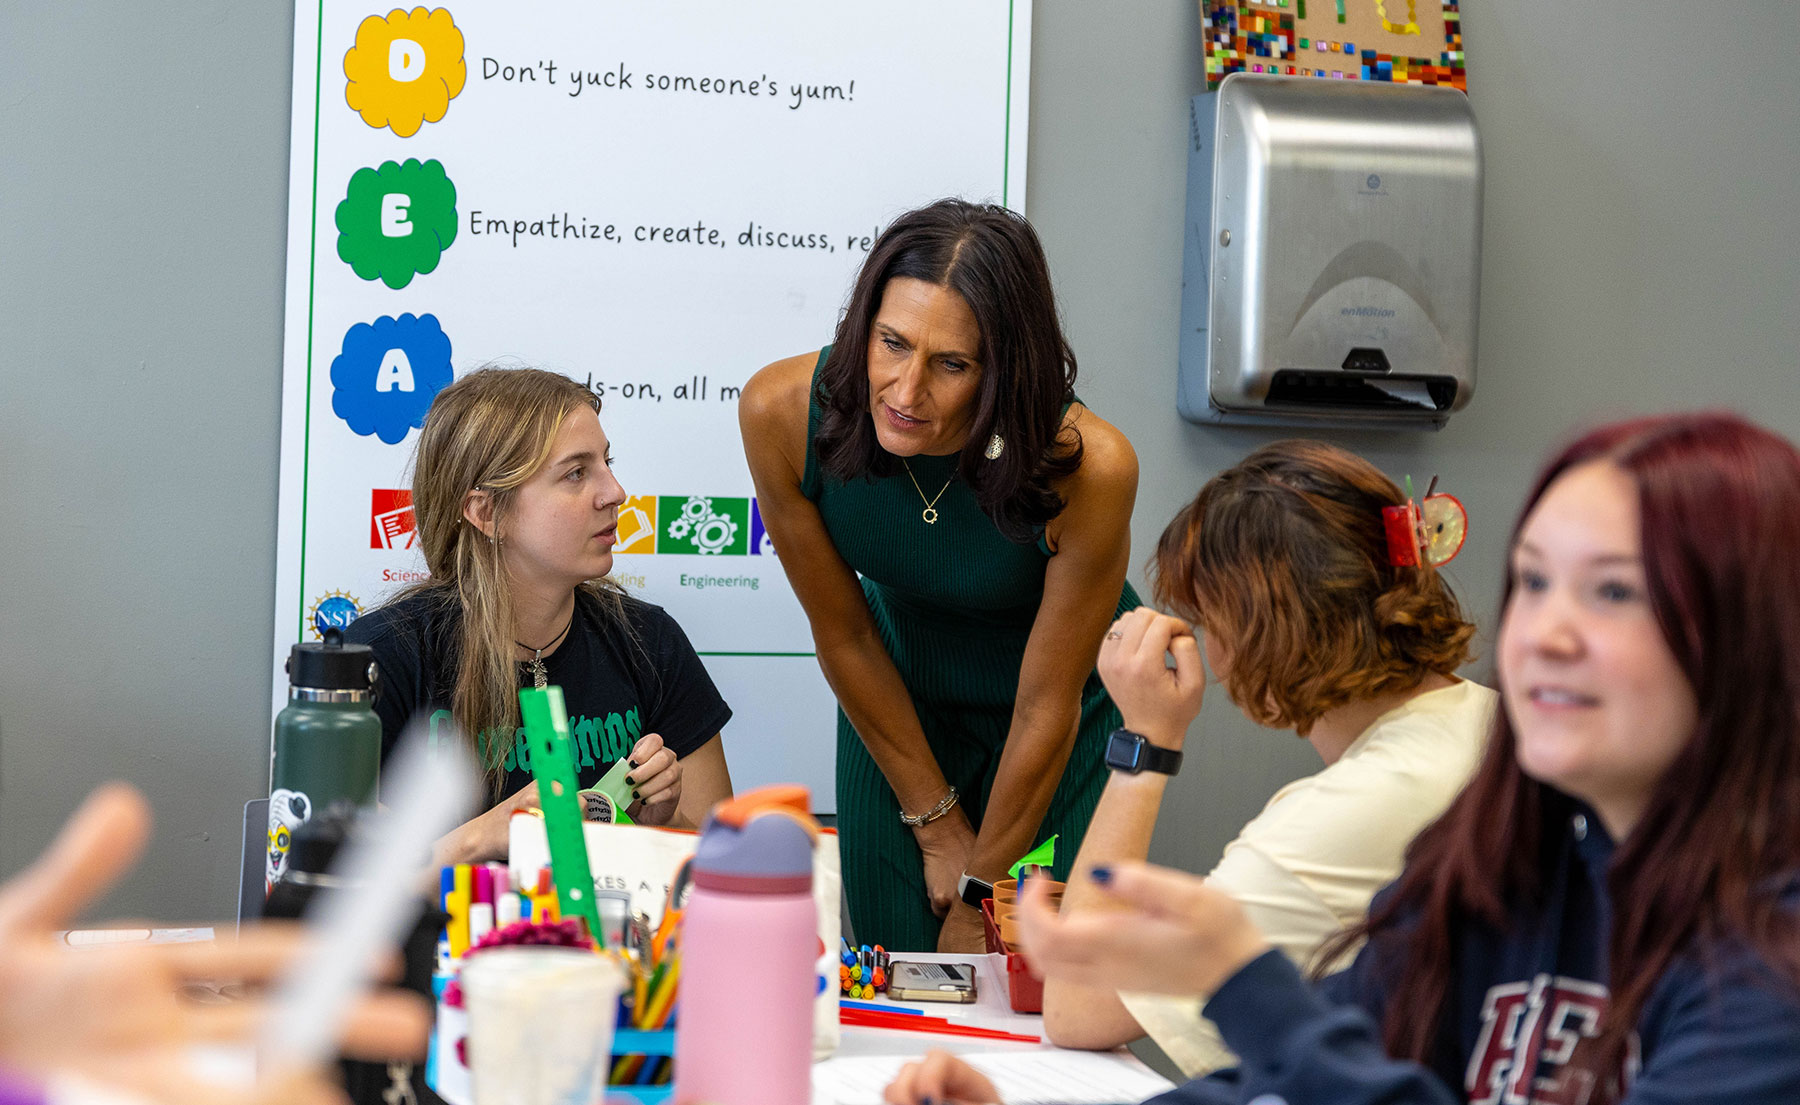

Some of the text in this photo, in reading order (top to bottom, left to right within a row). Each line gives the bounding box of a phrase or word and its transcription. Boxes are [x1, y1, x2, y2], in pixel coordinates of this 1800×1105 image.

[388, 38, 426, 82] D
[482, 57, 855, 110] Don't yuck someone's yum!
[381, 193, 413, 237] E
[470, 210, 879, 253] Empathize, create, discuss, rel
[376, 348, 415, 392] A
[585, 371, 741, 402] ds-on, all m
[382, 569, 432, 581] Scienc
[615, 573, 646, 588] ding
[679, 573, 760, 590] Engineering
[316, 610, 358, 627] NSF
[593, 876, 627, 889] KES
